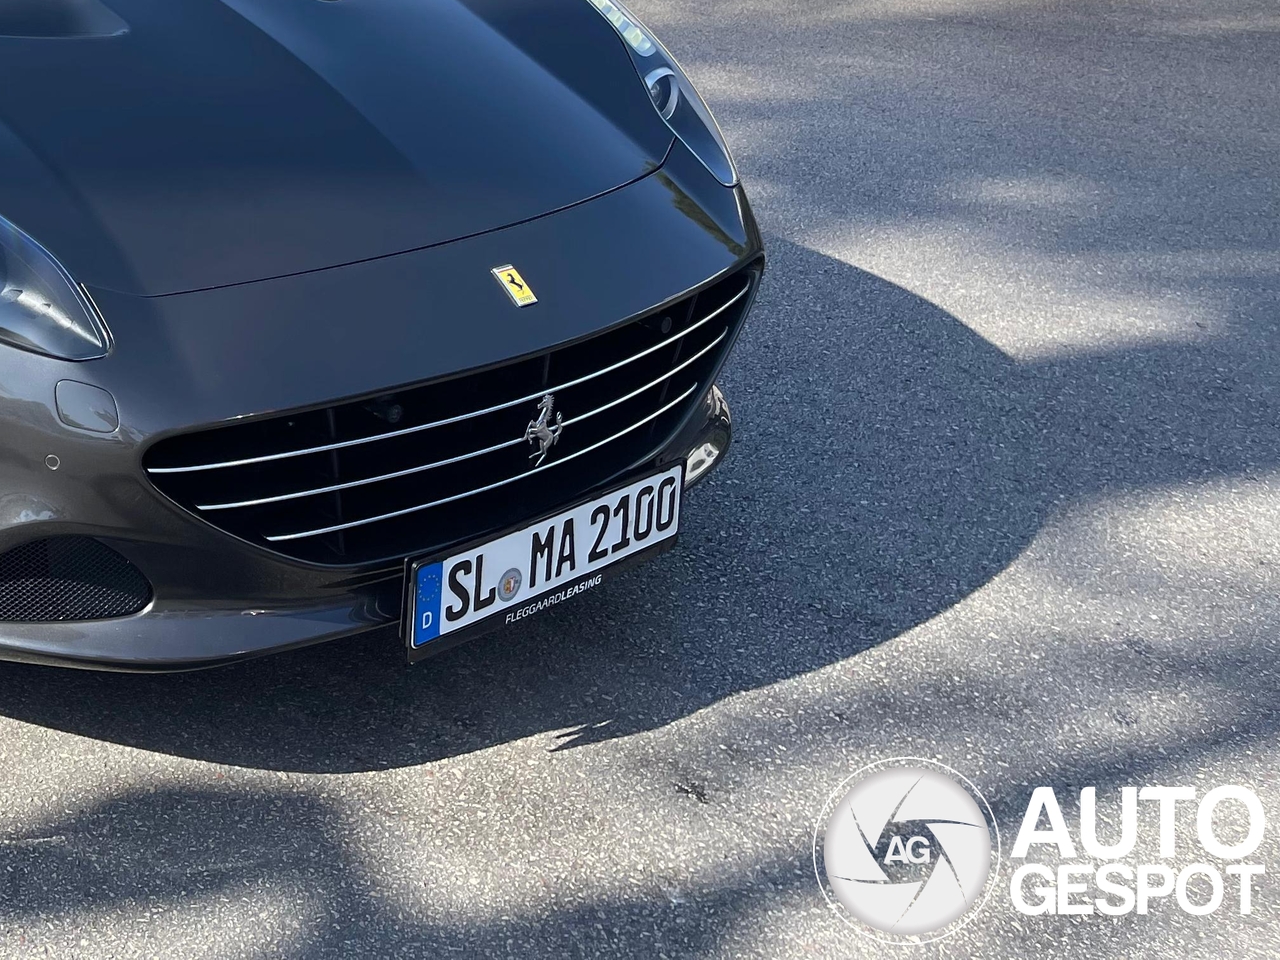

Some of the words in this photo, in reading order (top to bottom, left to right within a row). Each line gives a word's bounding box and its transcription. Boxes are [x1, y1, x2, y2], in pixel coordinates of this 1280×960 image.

[444, 554, 497, 622] SL
[528, 517, 577, 589] MA
[587, 475, 677, 564] 2100
[422, 611, 433, 630] D
[505, 573, 603, 625] FLEGGAARDLEASING
